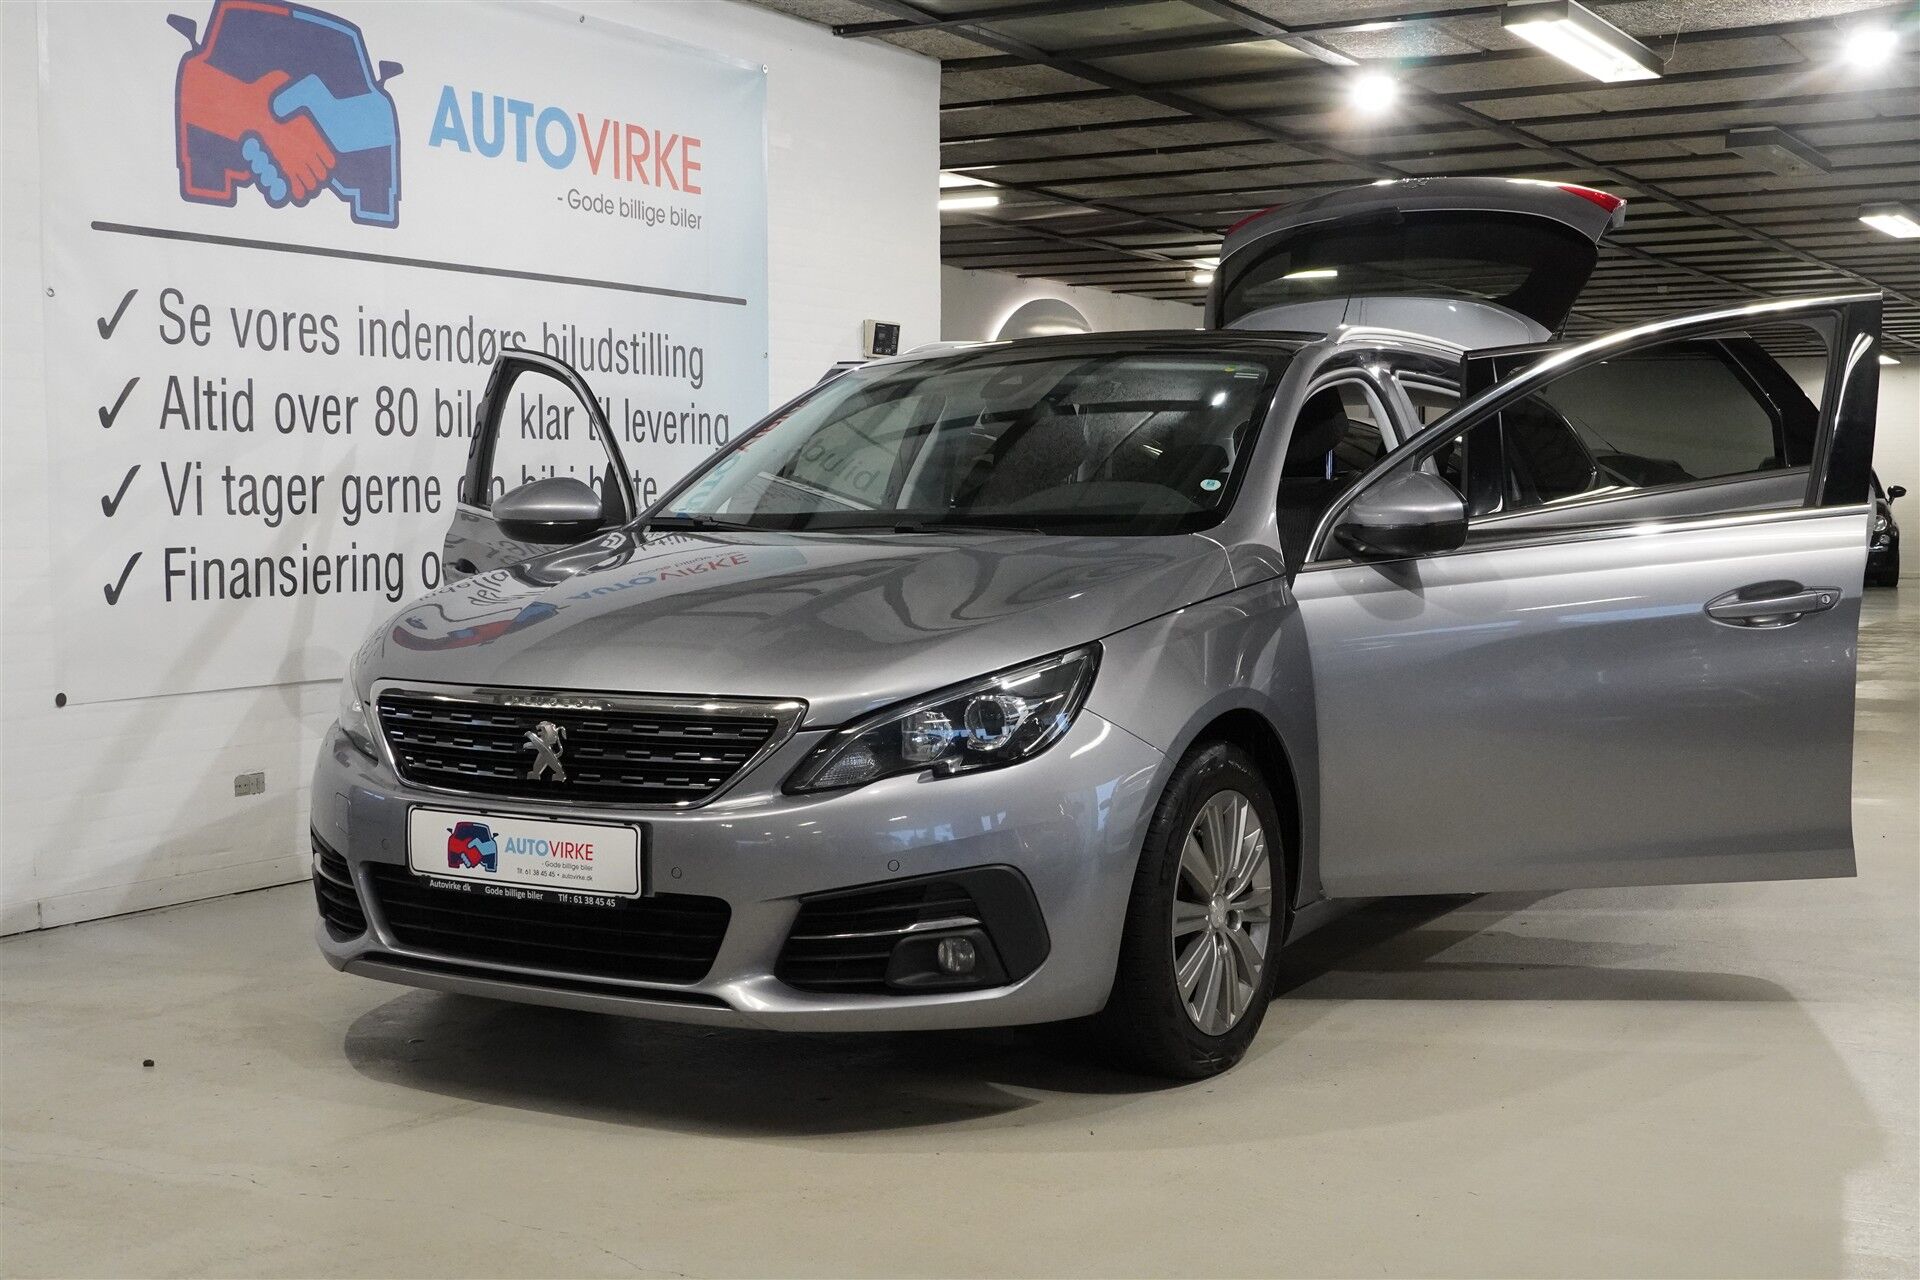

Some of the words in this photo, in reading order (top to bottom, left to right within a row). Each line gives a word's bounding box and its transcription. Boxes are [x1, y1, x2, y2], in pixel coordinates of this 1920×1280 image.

[428, 84, 702, 195] AUTOVIRKE
[567, 188, 614, 215] Gode
[619, 197, 666, 227] billige
[670, 207, 702, 230] biler
[159, 287, 211, 346] Se
[230, 307, 340, 356] vores
[542, 321, 704, 390] biludstilling
[159, 375, 254, 433] Altid
[275, 392, 359, 435] over
[374, 385, 418, 438] 80
[435, 387, 482, 438] bil
[520, 387, 575, 441] klar
[624, 398, 729, 451] levering
[160, 461, 203, 516] Vi
[221, 465, 325, 528] tager
[342, 475, 441, 527] gerne
[164, 541, 404, 603] Finansiering
[504, 836, 594, 861] AUTOVIRKE
[525, 868, 532, 876] 61
[540, 870, 548, 878] 45
[544, 860, 561, 868] Gode
[562, 863, 580, 871] billige
[484, 886, 504, 896] Gode
[504, 887, 526, 900] billige
[526, 891, 544, 901] biler
[573, 895, 583, 904] 61
[584, 896, 594, 905] 38
[595, 897, 605, 907] 45
[605, 898, 616, 908] 45
